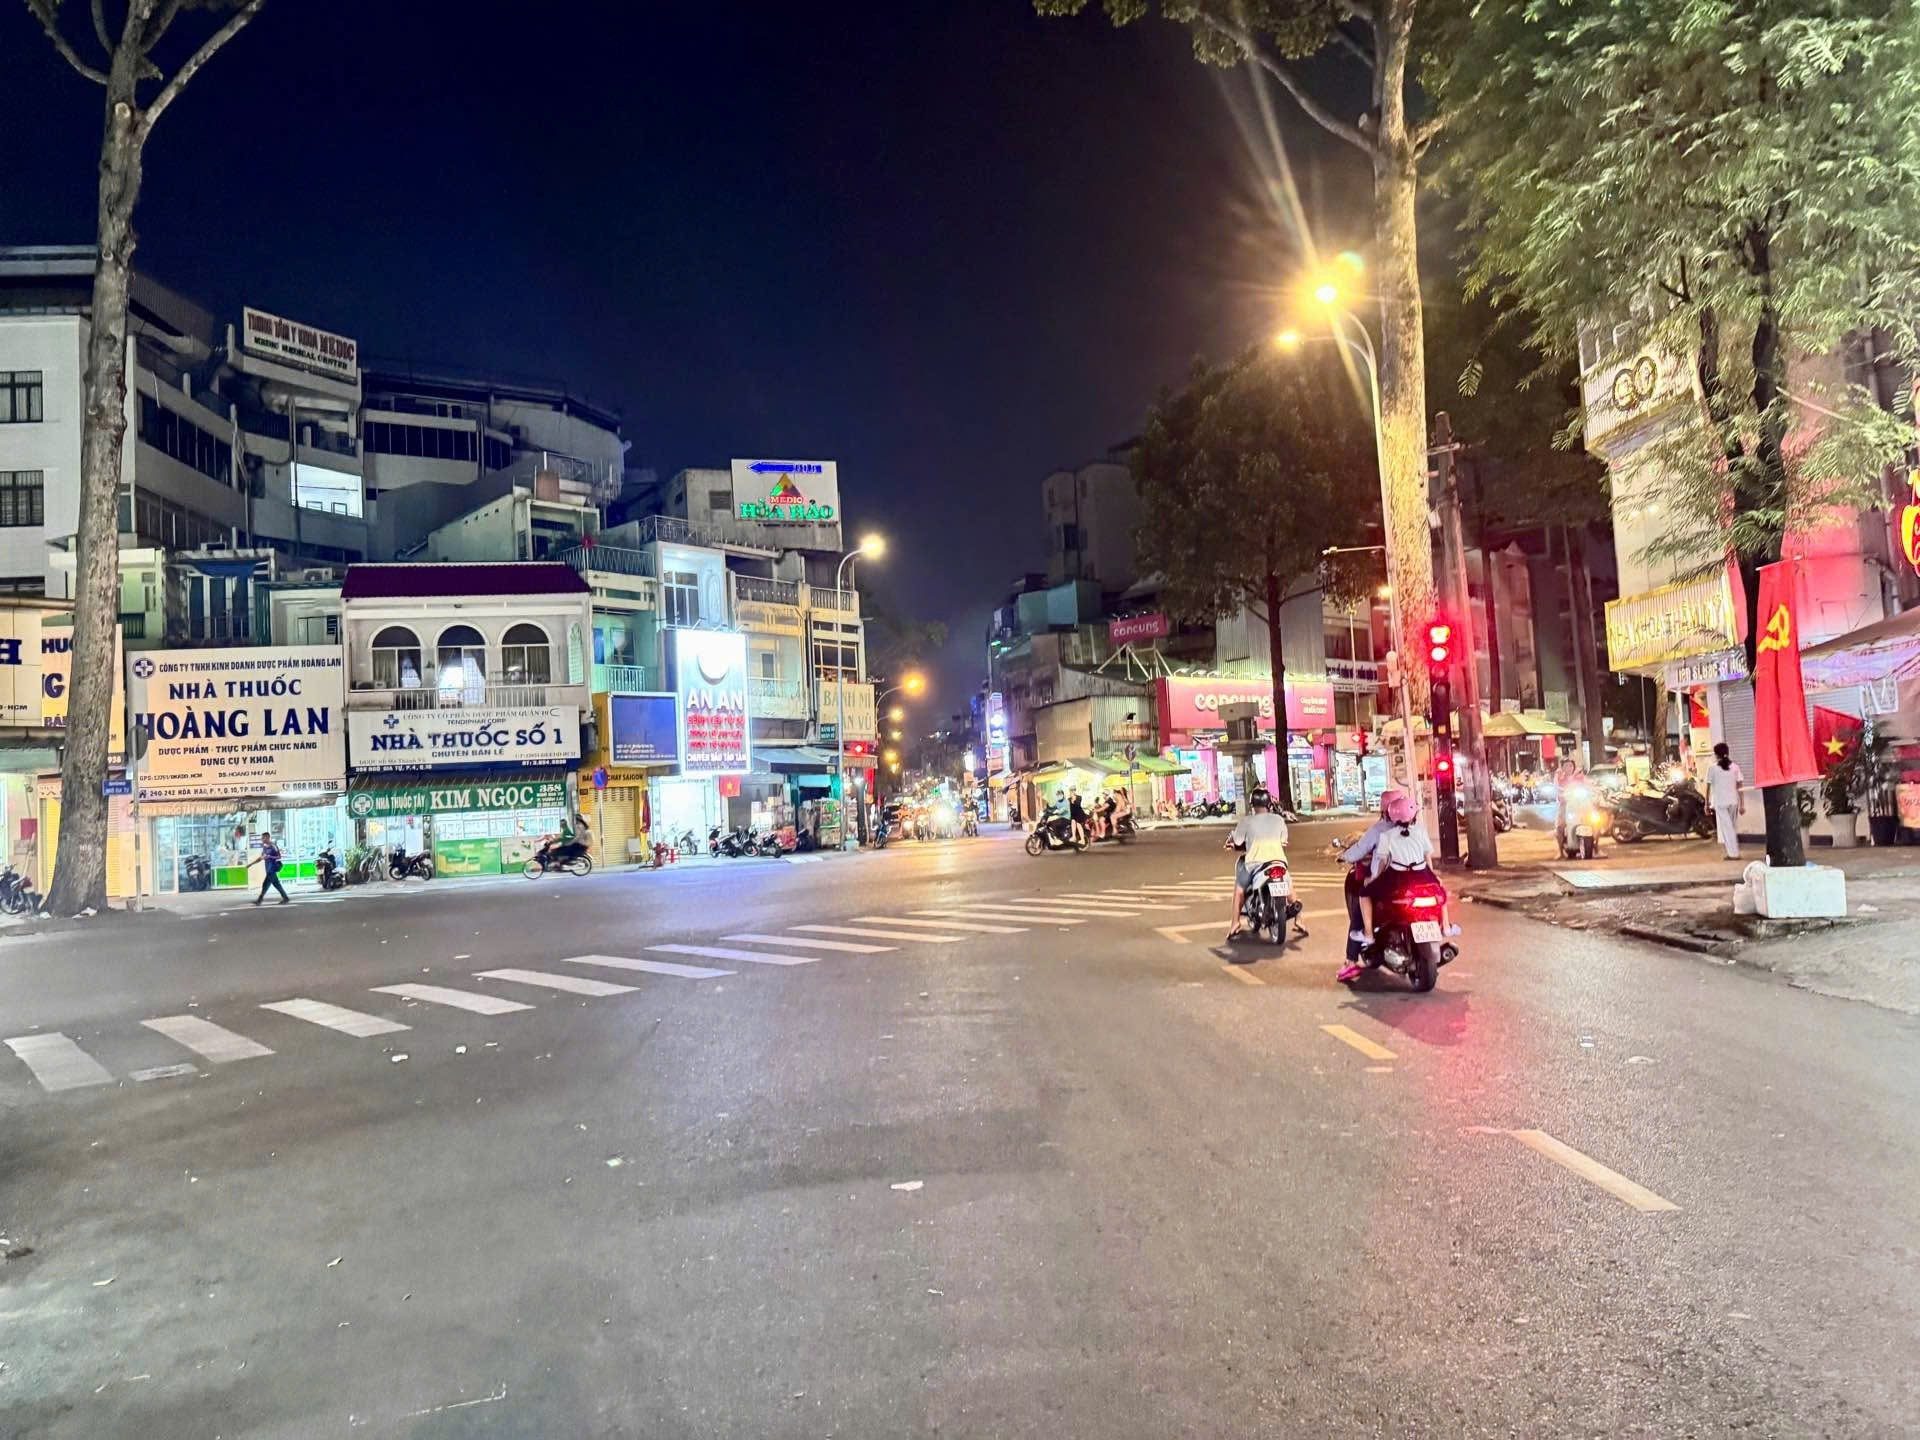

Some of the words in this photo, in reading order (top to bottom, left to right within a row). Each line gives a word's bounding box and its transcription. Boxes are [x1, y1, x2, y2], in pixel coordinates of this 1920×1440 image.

[319, 333, 355, 361] MEDIC
[1113, 620, 1160, 637] concung
[190, 662, 211, 672] TNHH
[211, 661, 230, 671] KINH
[230, 660, 255, 670] DOANH
[326, 657, 342, 667] LAN
[169, 678, 217, 700] NHÀ
[224, 673, 302, 698] THUỐC
[686, 688, 713, 709] AN
[718, 688, 744, 710] AN
[135, 705, 249, 741] HOÀNG
[263, 707, 329, 737] LAN
[370, 727, 424, 751] NHÀ
[428, 723, 510, 749] THUỐC
[516, 721, 546, 746] SỐ
[553, 728, 563, 745] 1
[241, 756, 248, 765] Y
[249, 755, 274, 765] KHOA
[391, 791, 413, 809] THUỐC
[429, 788, 471, 810] KIM
[476, 785, 534, 809] NGỌC
